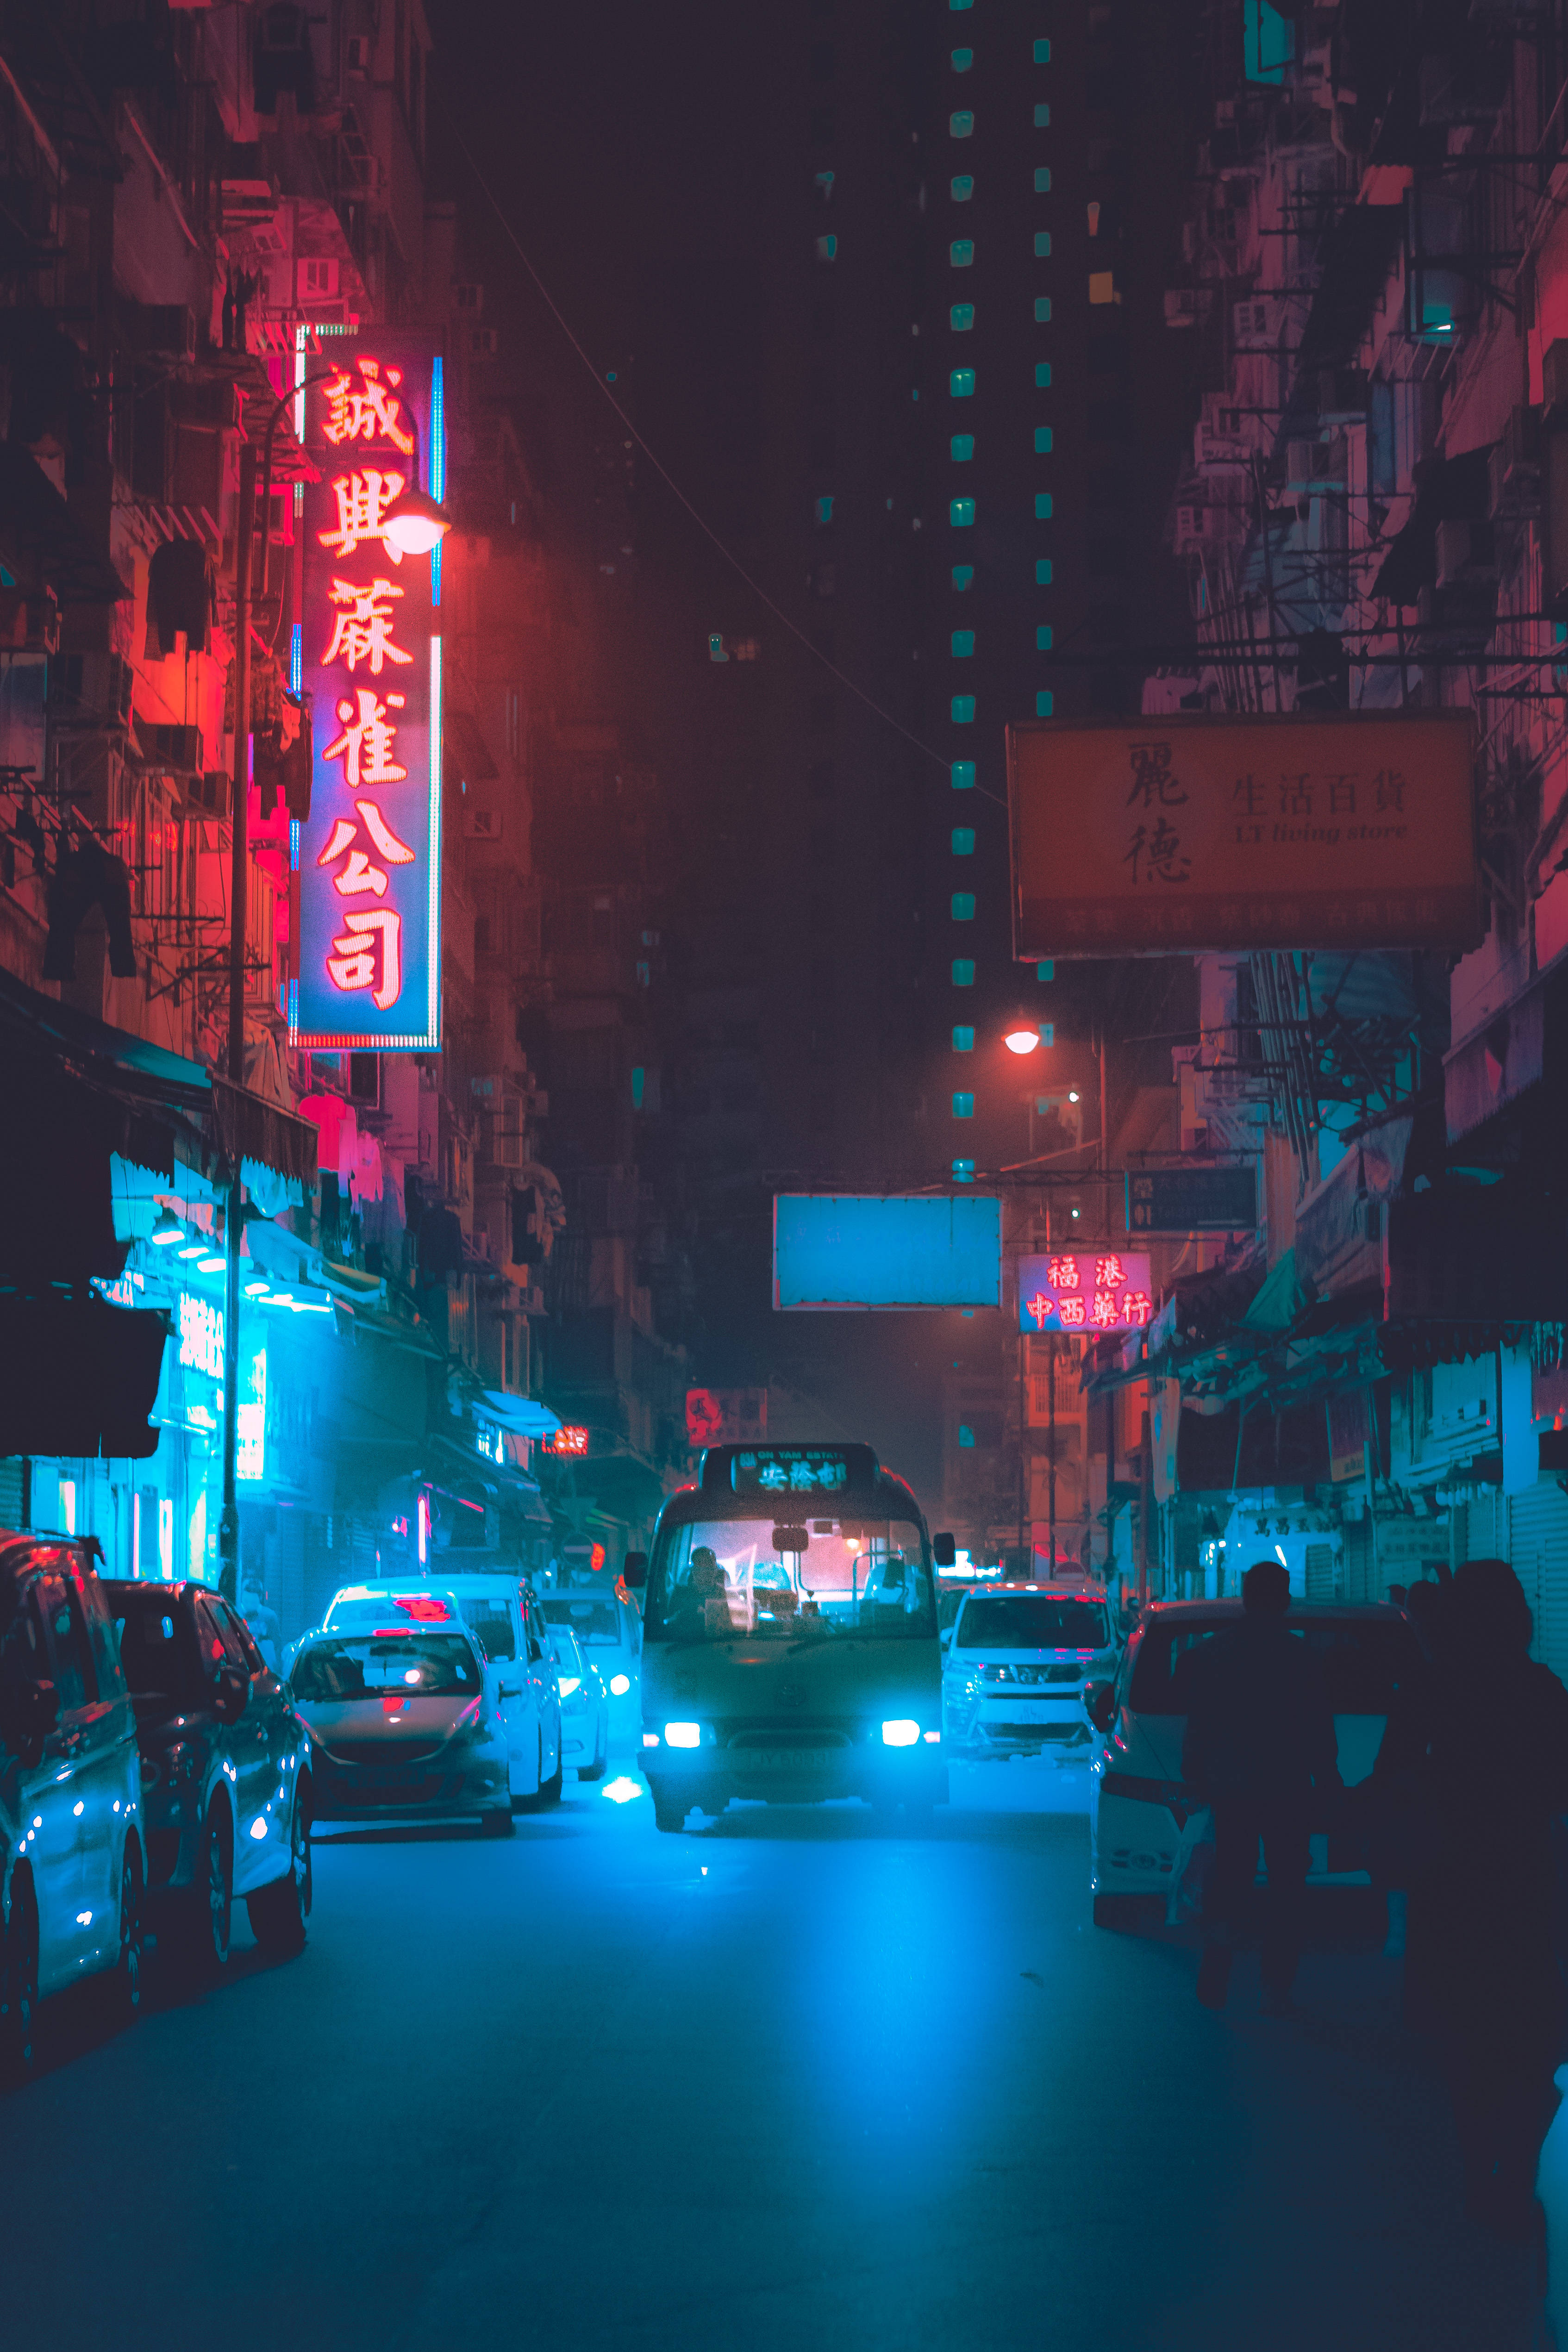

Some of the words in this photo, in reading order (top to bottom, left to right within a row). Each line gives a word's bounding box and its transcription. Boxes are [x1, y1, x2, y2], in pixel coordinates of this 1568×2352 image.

[1231, 769, 1406, 816] 生活百貨
[1122, 742, 1192, 886] 麗德
[1272, 823, 1340, 846] living
[1346, 824, 1408, 841] store
[1047, 1254, 1128, 1290] 福港
[1026, 1290, 1152, 1329] 中西藥行
